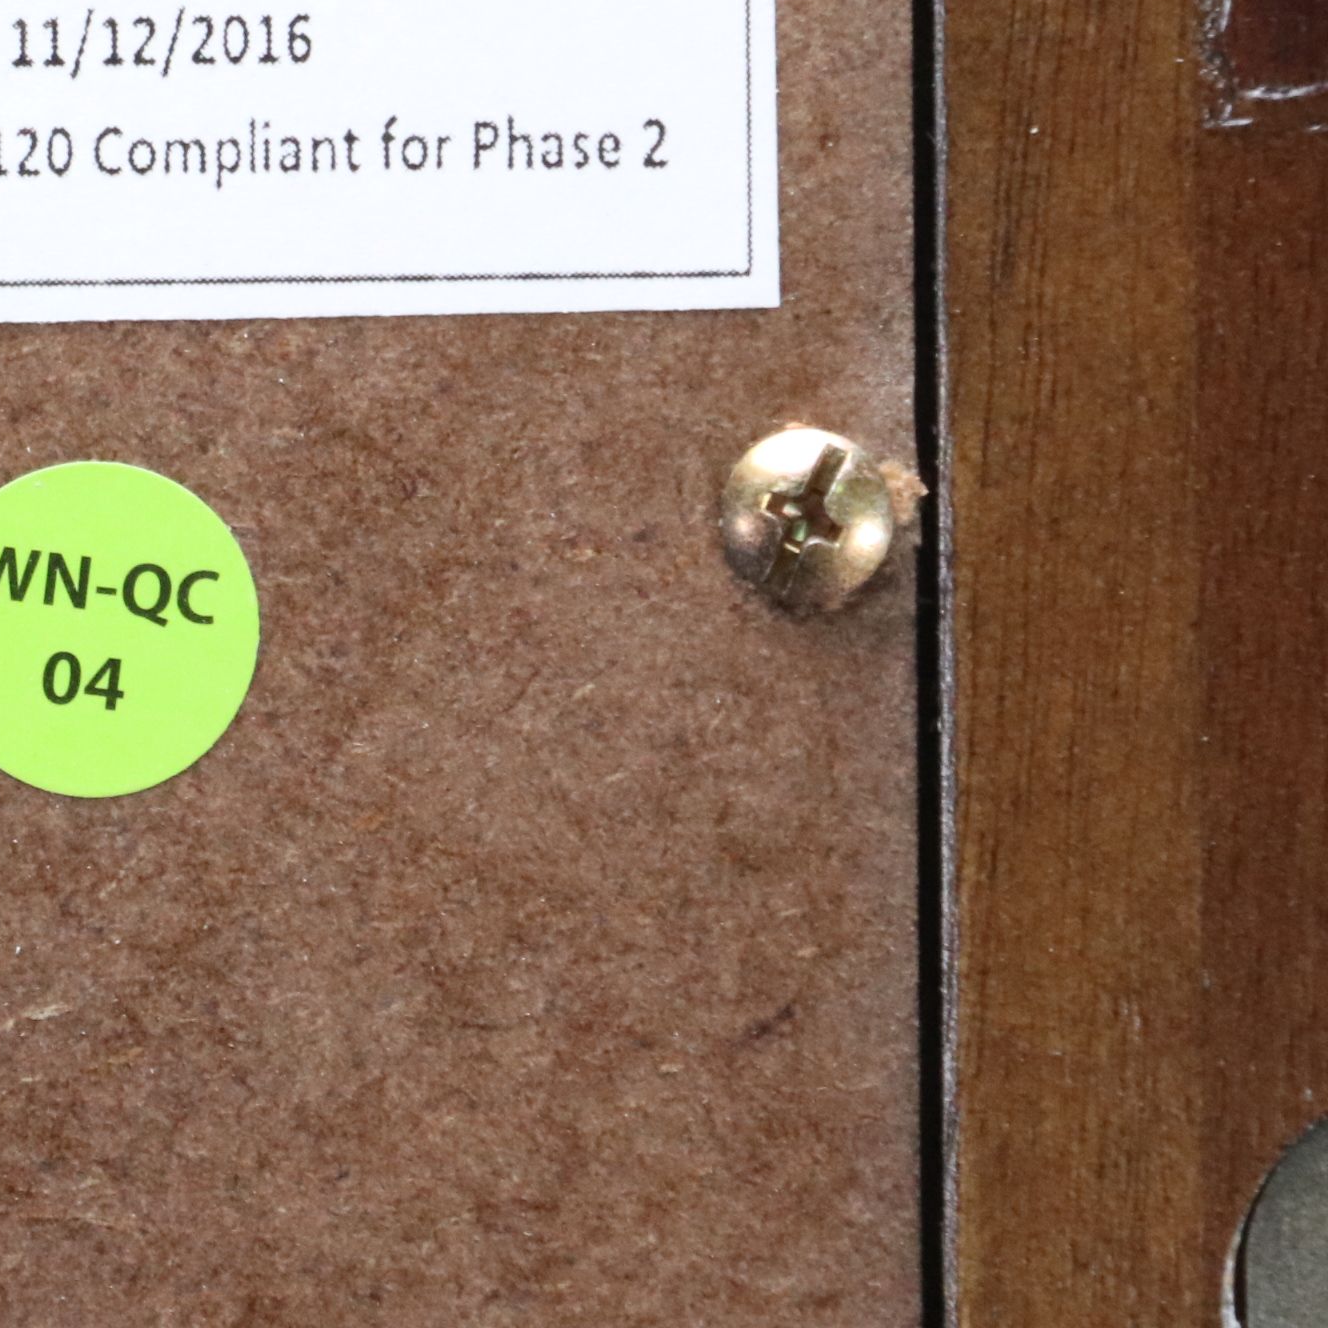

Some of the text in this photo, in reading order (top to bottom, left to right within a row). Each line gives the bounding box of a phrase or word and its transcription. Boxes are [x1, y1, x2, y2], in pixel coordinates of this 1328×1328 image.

[12, 7, 312, 79] 11/12/2016
[94, 117, 359, 189] Compliant
[381, 116, 450, 170] for
[473, 116, 620, 169] Phase
[643, 119, 668, 169] 2
[42, 651, 125, 711] 04
